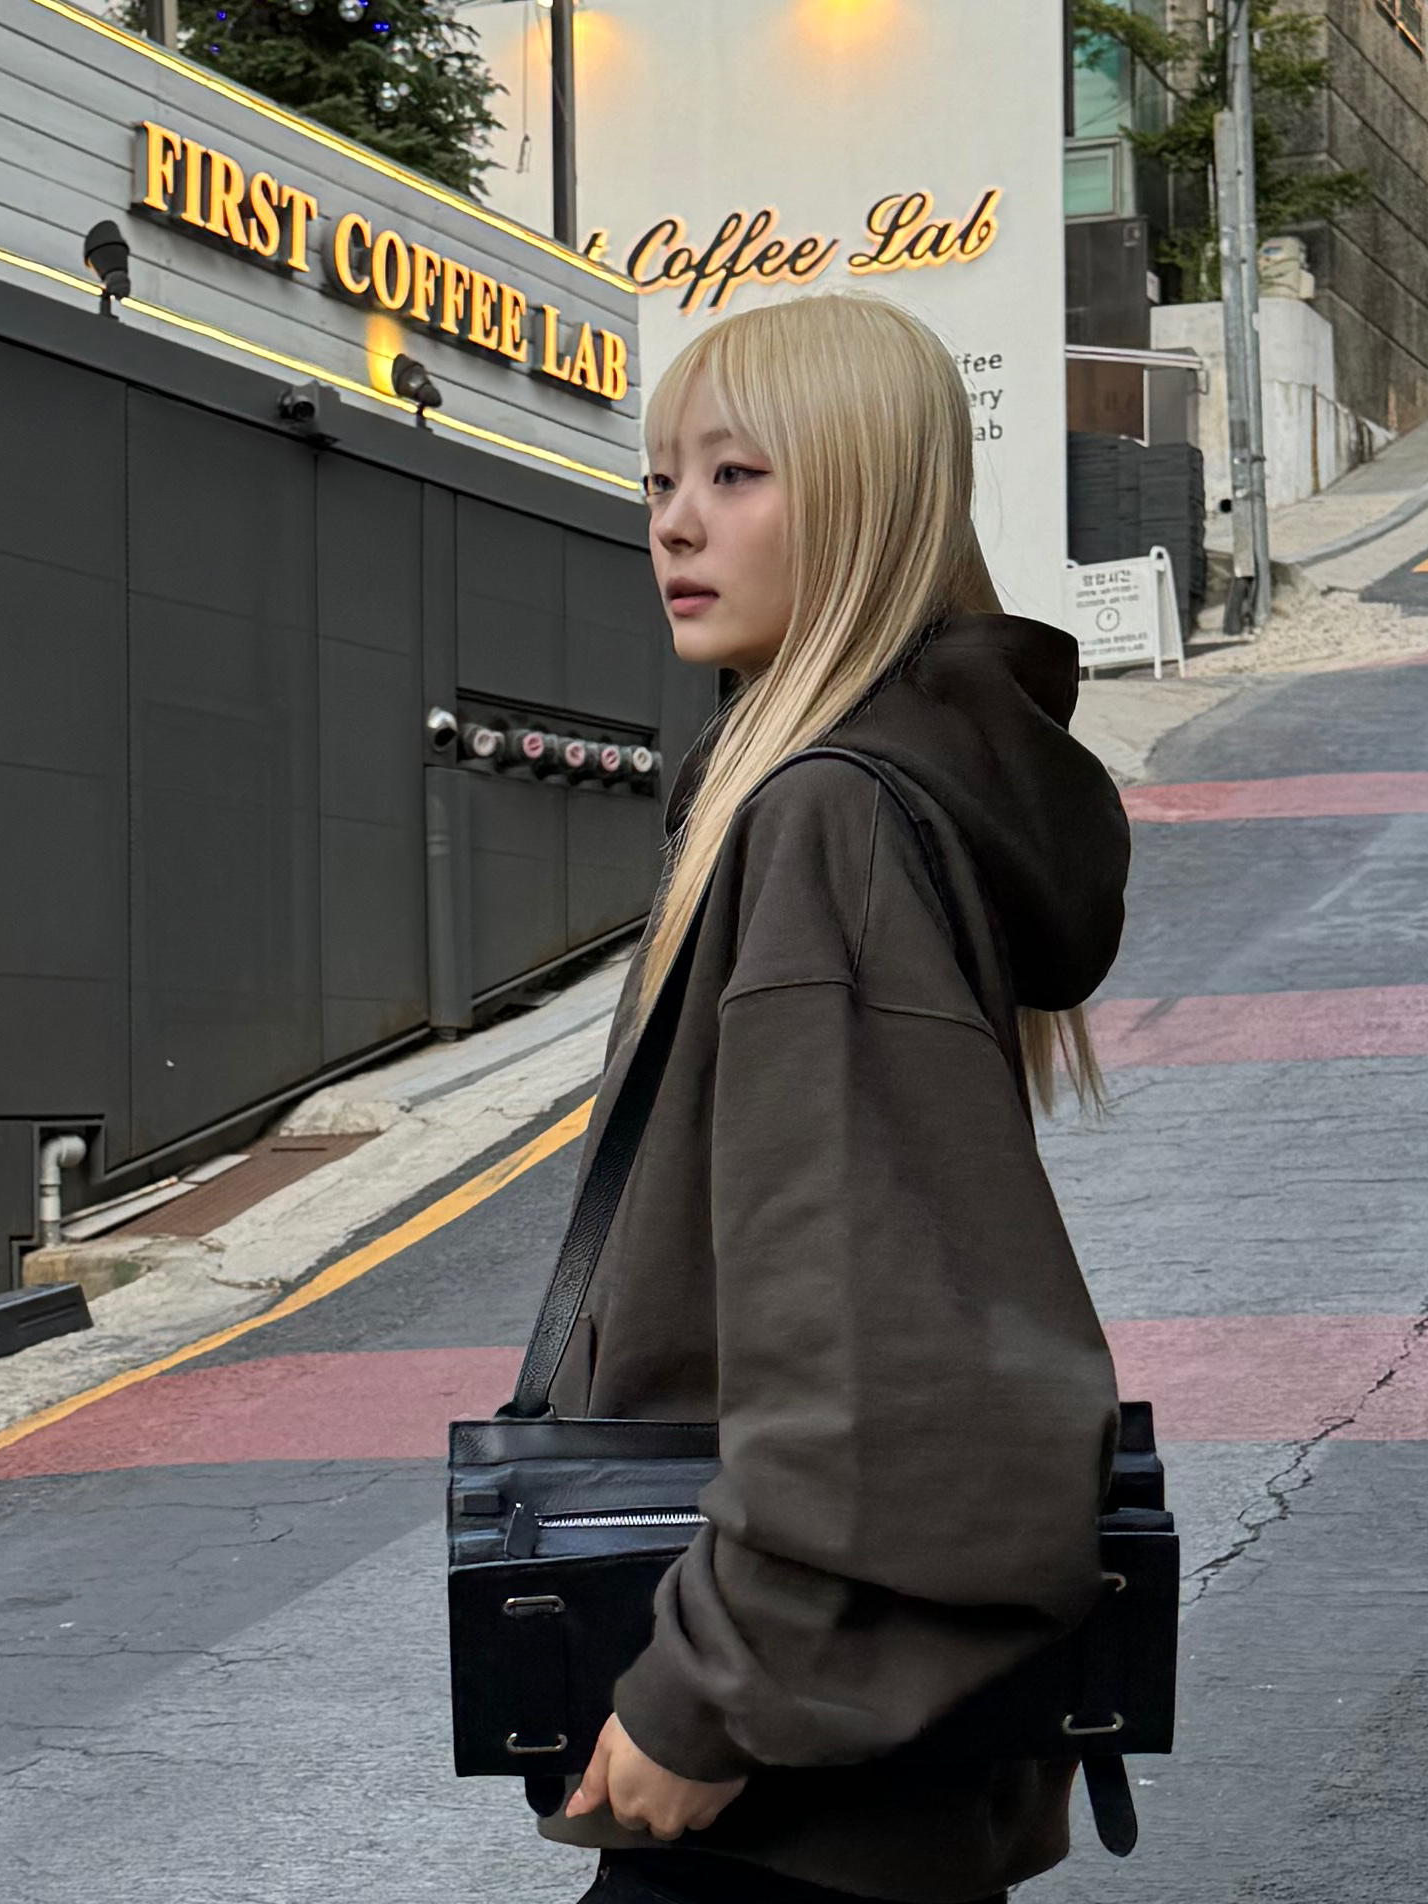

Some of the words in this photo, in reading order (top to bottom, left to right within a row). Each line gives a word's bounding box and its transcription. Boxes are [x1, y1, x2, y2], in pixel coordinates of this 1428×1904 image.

[139, 120, 318, 273] FIRST
[330, 212, 529, 363] COFFEE
[541, 303, 629, 401] LAB
[627, 208, 841, 311] Coffee
[849, 189, 1003, 270] Lab
